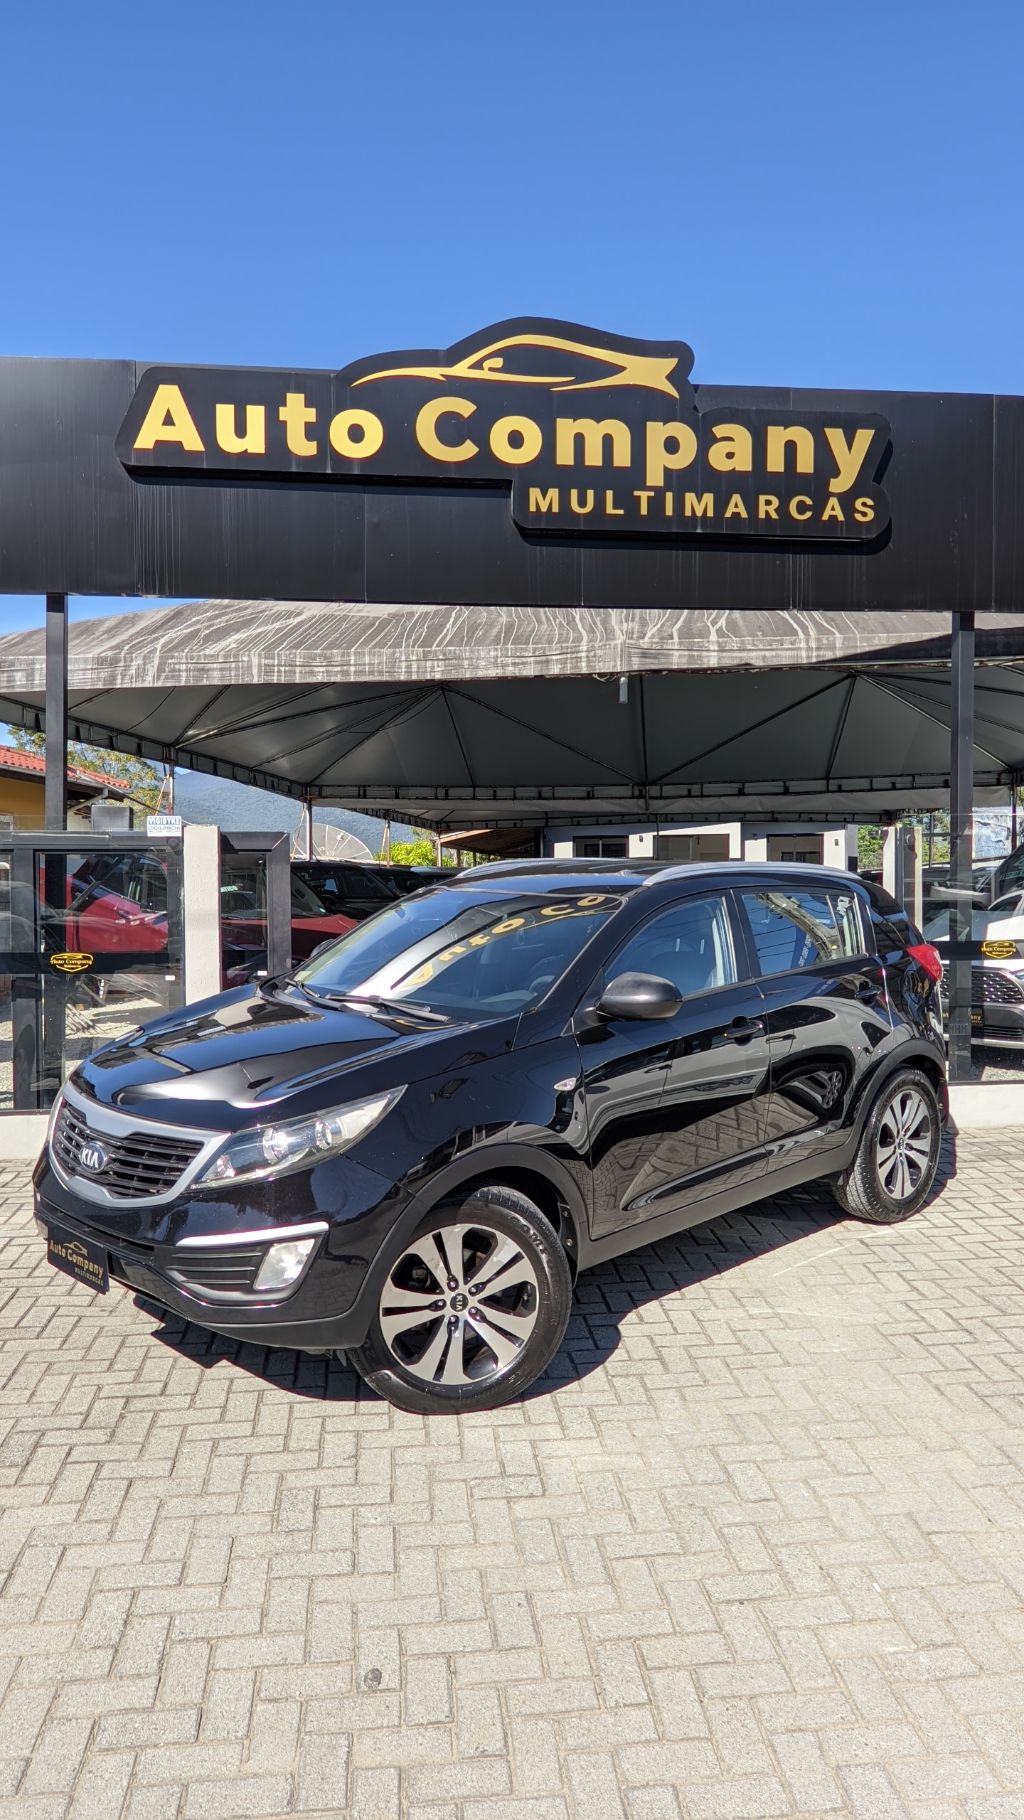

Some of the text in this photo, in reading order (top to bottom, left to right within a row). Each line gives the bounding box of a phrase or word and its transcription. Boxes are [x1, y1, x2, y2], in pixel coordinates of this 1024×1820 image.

[133, 384, 876, 494] Auto Company
[529, 487, 876, 522] MULTIMARCAS
[65, 958, 93, 966] Company
[81, 1147, 99, 1168] KIA
[50, 1239, 104, 1279] Auto Company
